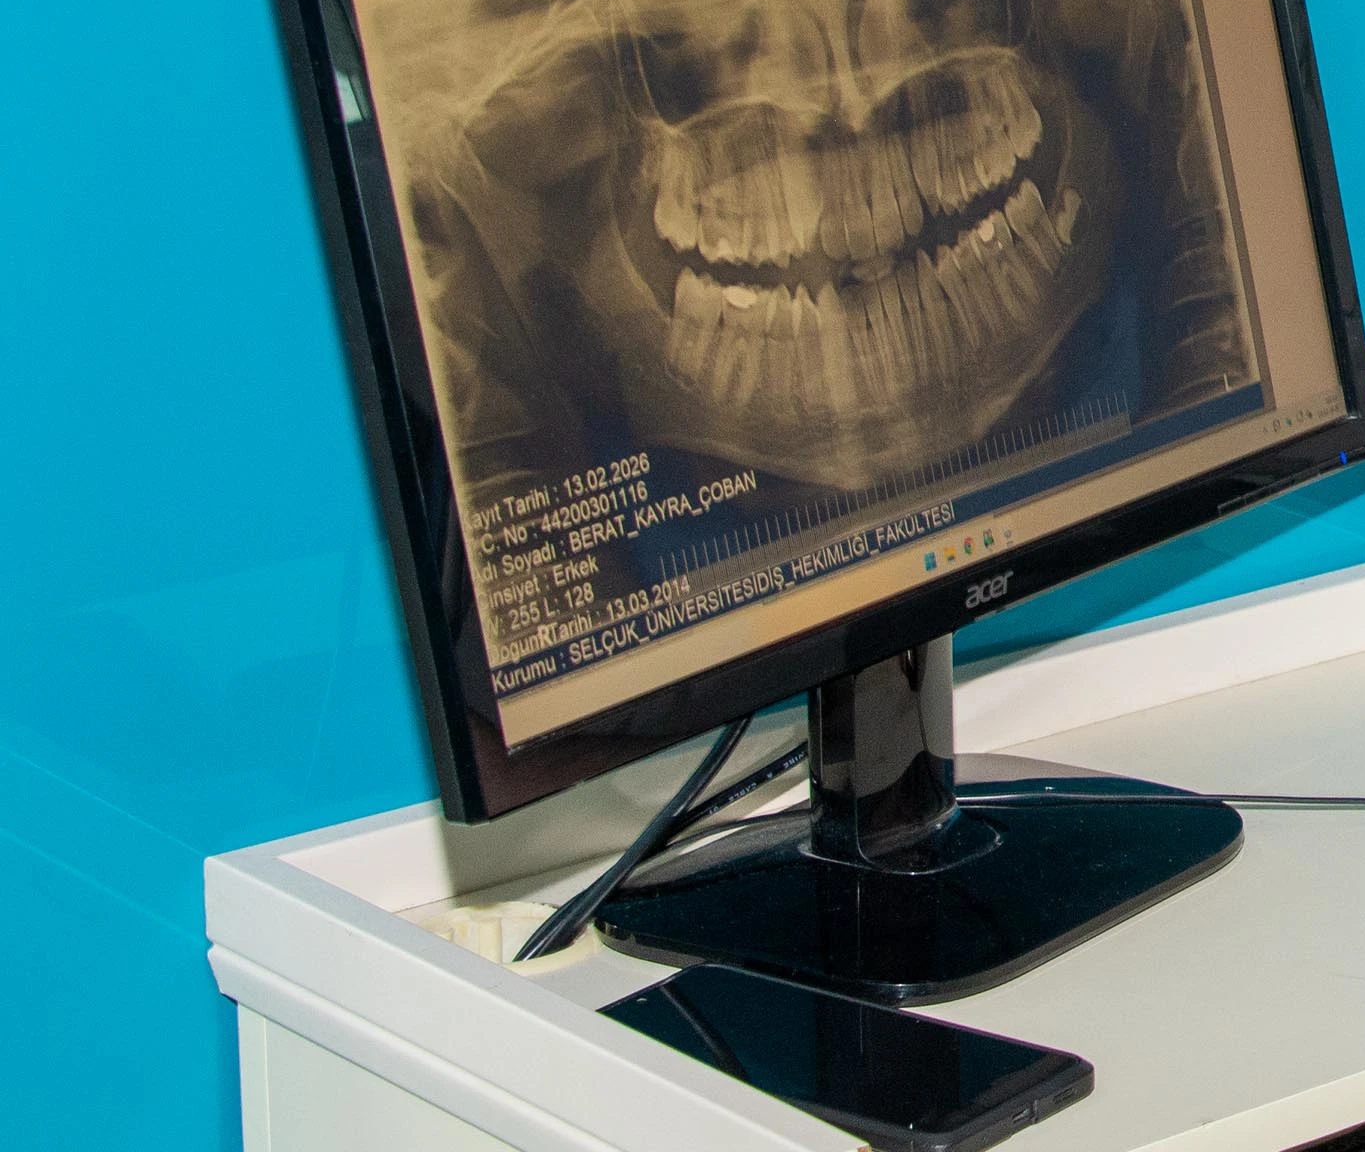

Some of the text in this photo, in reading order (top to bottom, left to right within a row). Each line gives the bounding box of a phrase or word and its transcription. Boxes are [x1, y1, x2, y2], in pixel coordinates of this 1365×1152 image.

[465, 502, 502, 531] ayıt
[503, 484, 550, 517] Tarihi
[563, 451, 651, 499] 13.02.2026
[503, 524, 527, 547] No
[541, 481, 649, 533] 44200301116
[502, 540, 557, 576] Soyadı
[568, 470, 757, 554] BERAT_KAYRA_ÇOBAN
[553, 554, 599, 587] Erkek
[965, 571, 1014, 608] acer
[508, 601, 541, 630] 255
[564, 583, 594, 609] 128
[605, 575, 690, 623] 13.03.2014
[492, 654, 556, 695] Kurumu
